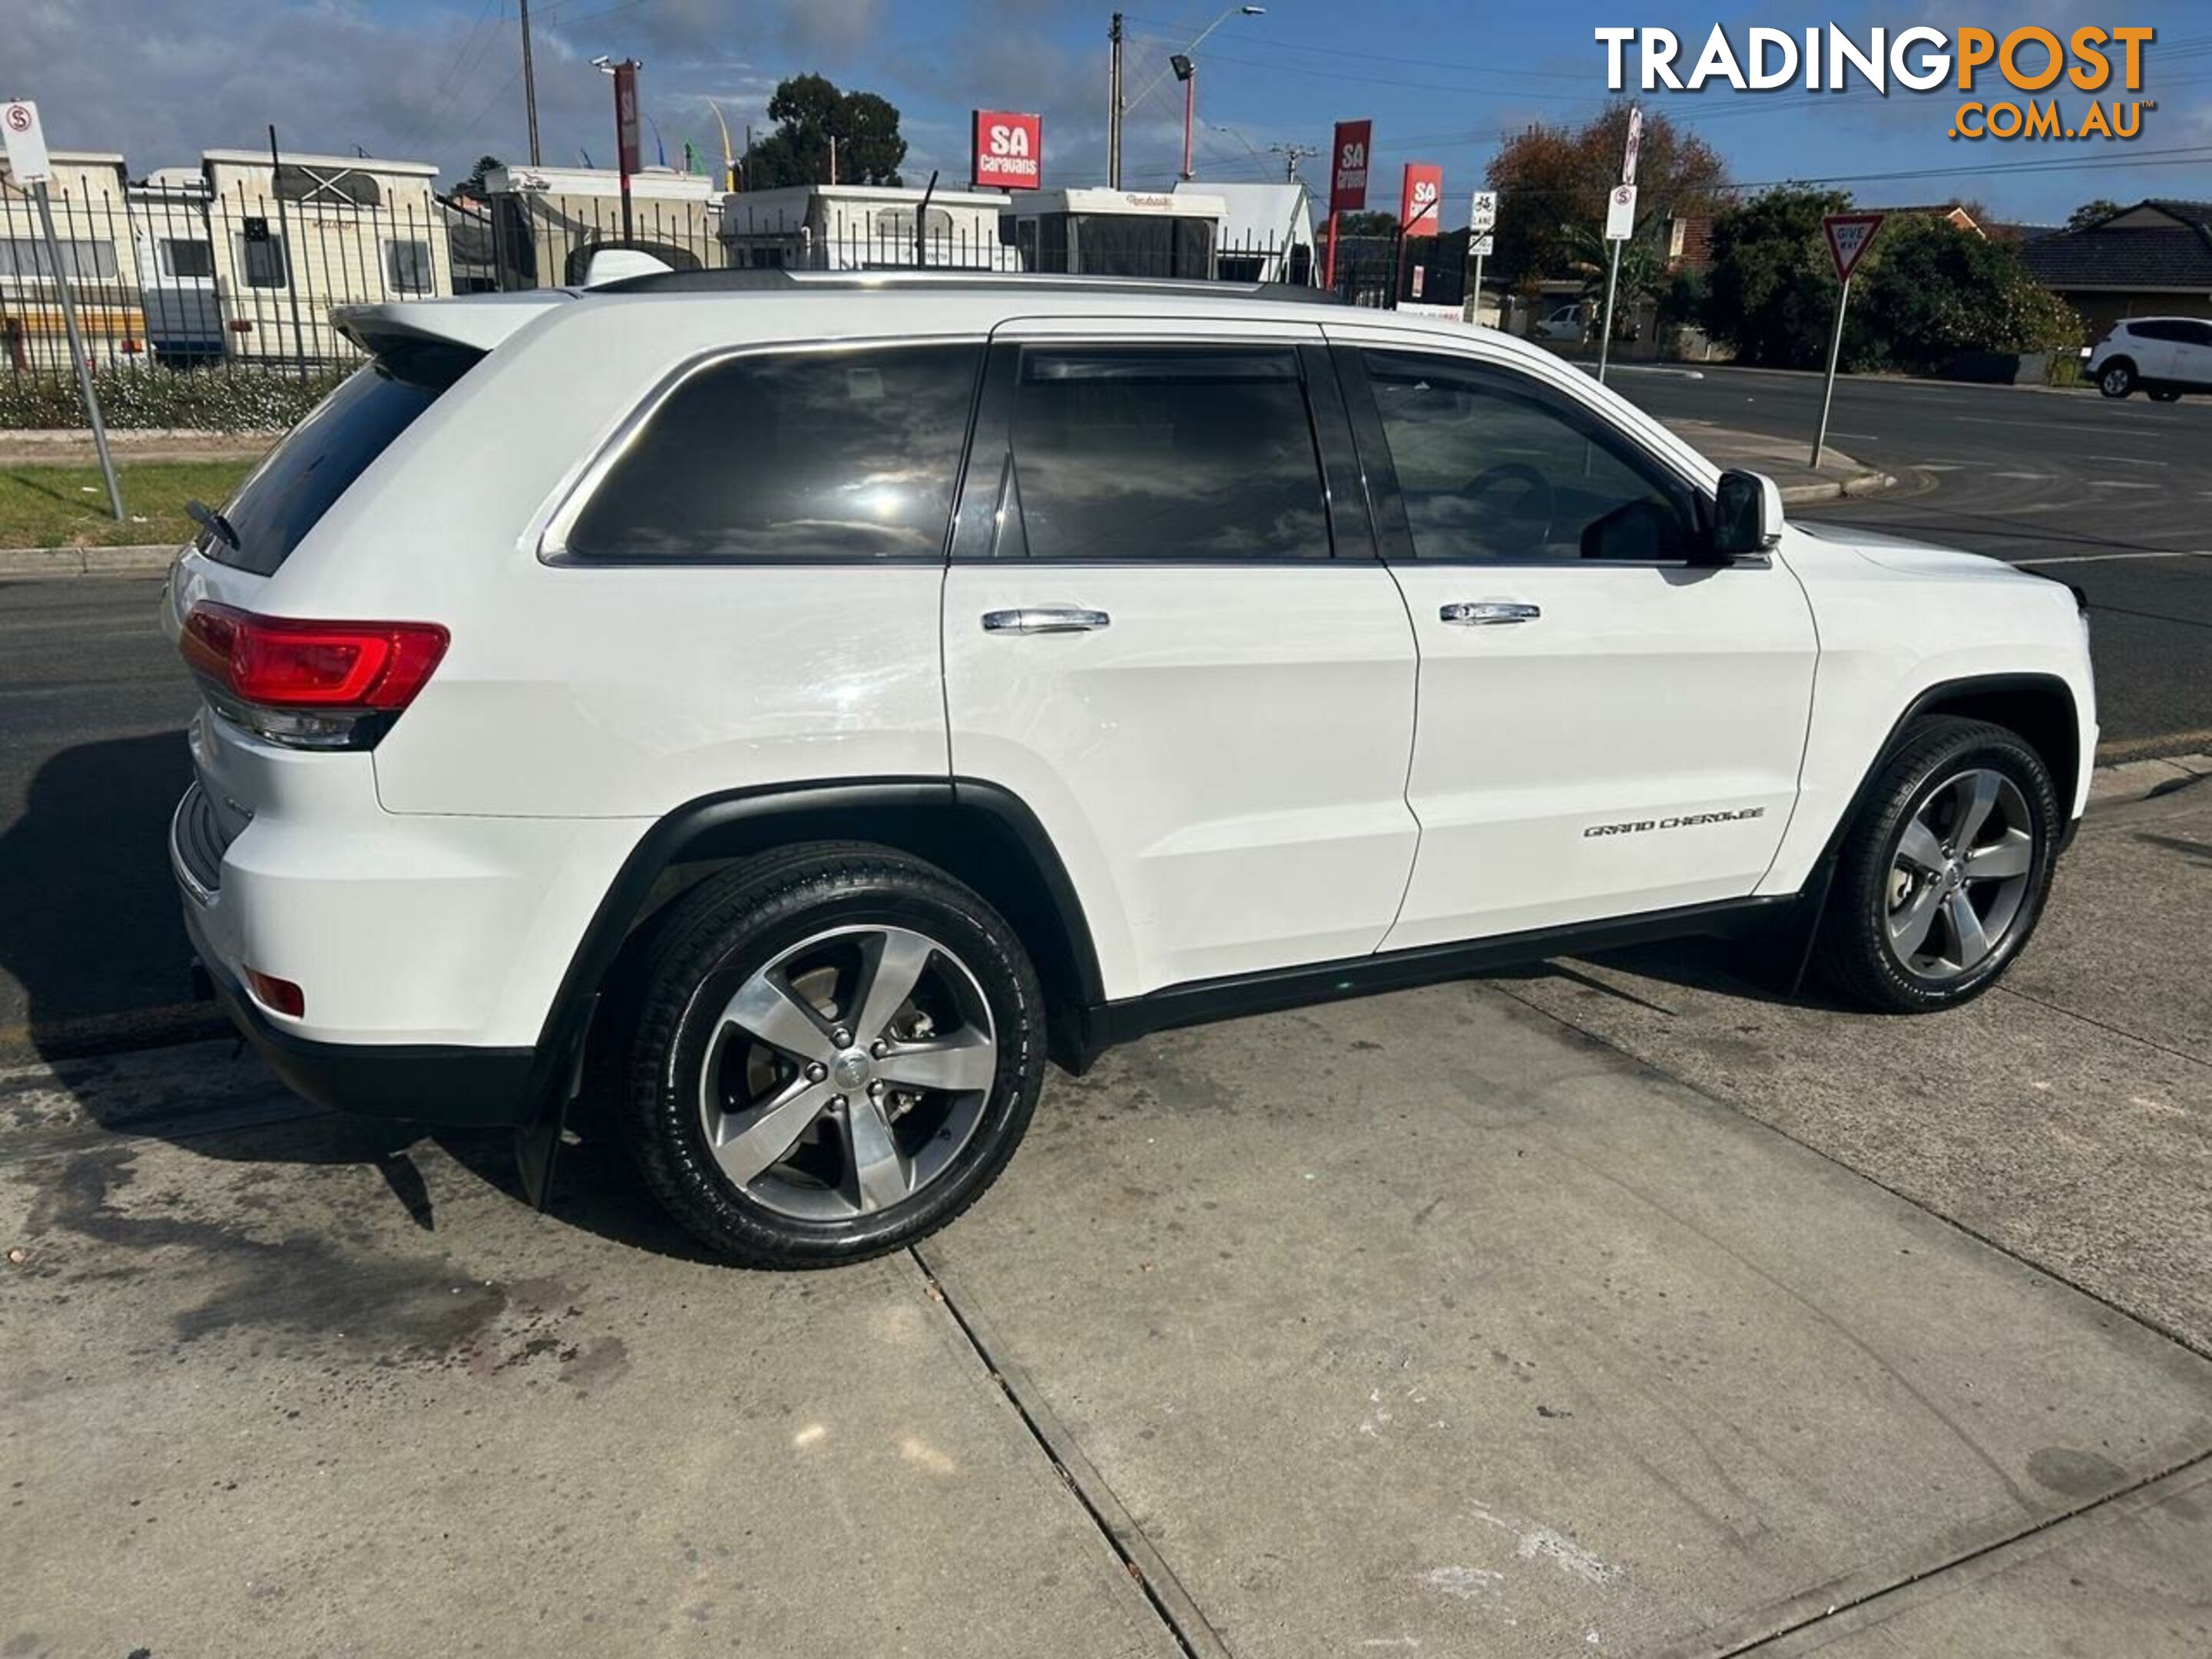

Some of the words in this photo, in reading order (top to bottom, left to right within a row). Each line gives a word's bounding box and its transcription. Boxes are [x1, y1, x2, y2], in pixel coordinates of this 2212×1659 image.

[990, 125, 1029, 156] SA
[981, 154, 1036, 176] Caravans
[1342, 143, 1364, 168] SA
[1415, 182, 1435, 202] SA
[1837, 227, 1864, 240] GIVE
[1840, 241, 1858, 250] WAY
[1584, 820, 1656, 838] GRAND
[1660, 807, 1765, 830] CHEROKEE
